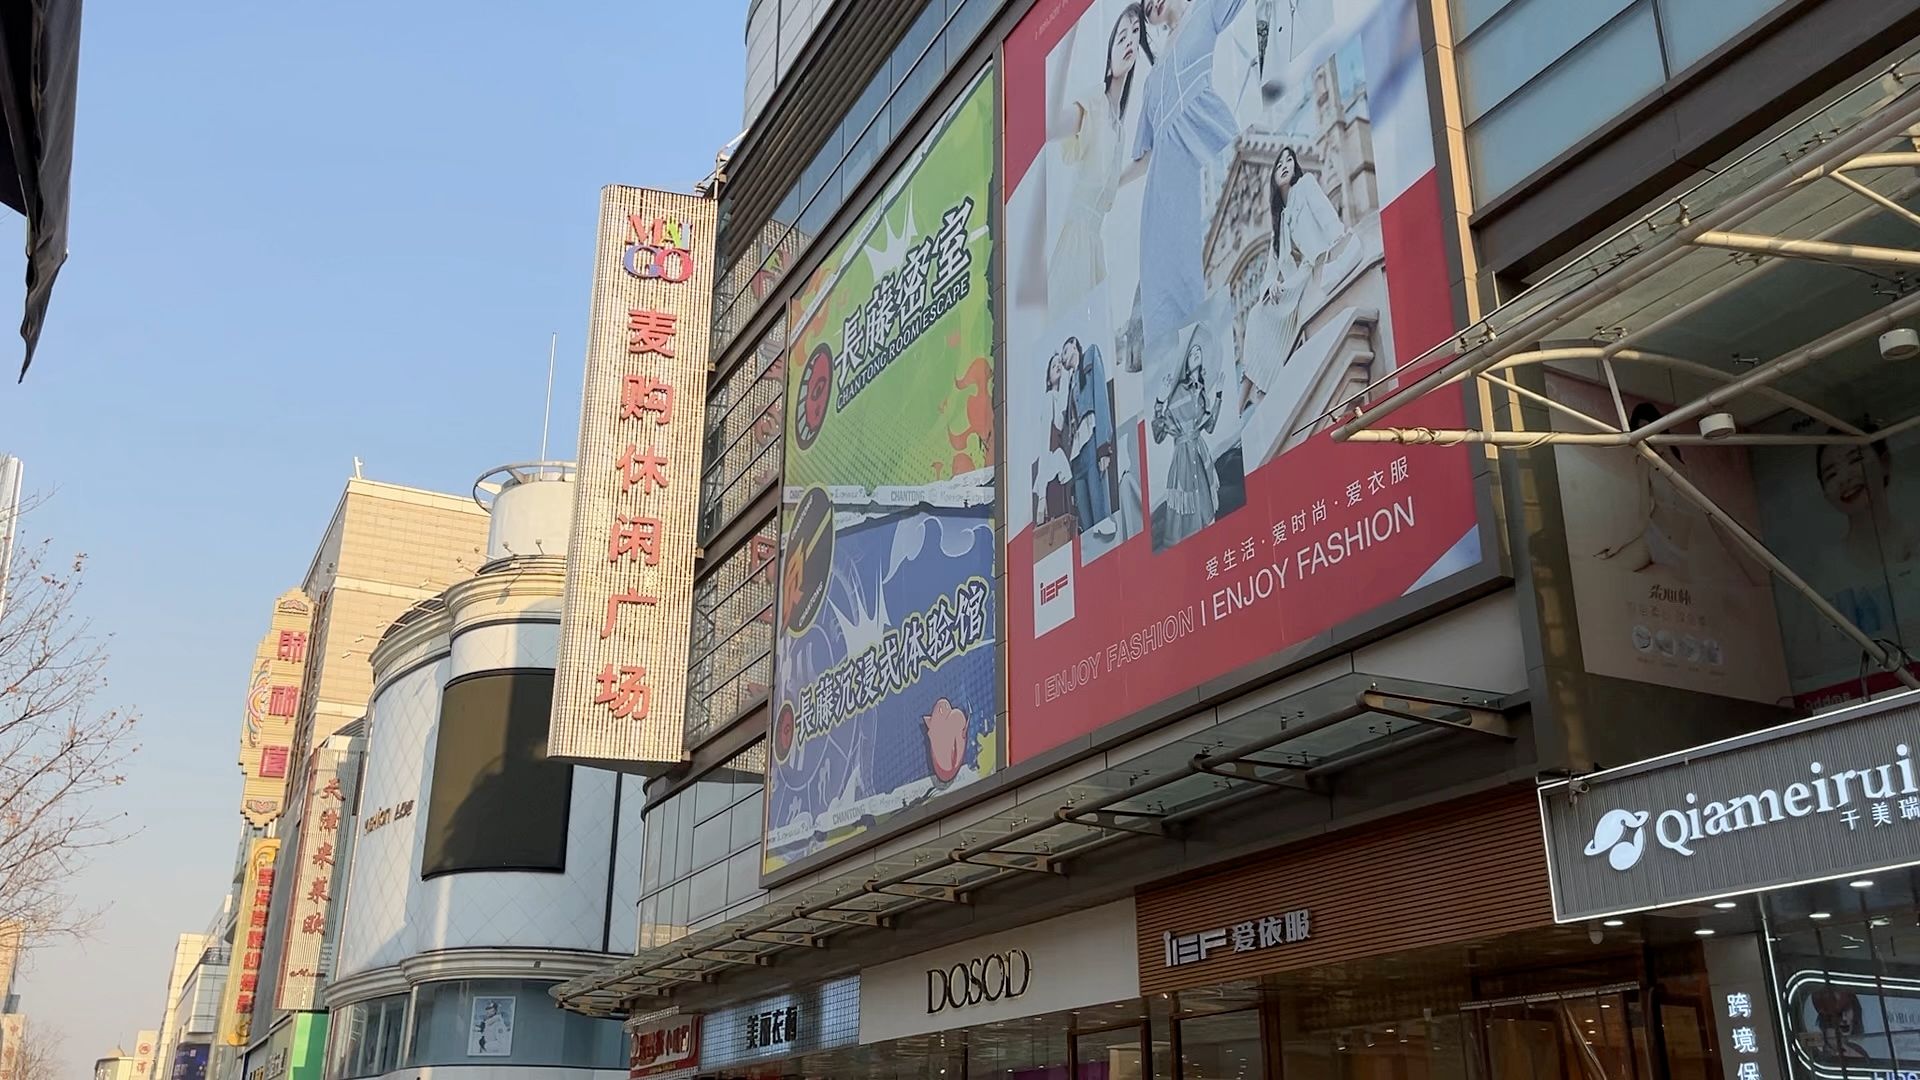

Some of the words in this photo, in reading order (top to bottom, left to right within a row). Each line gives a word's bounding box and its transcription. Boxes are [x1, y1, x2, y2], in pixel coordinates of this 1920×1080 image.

[838, 353, 888, 410] CHANTONG
[889, 322, 920, 358] ROOM
[922, 276, 969, 329] ESCAPE
[594, 309, 677, 720] 麦购休闲广场
[1045, 652, 1102, 703] ENJOY
[1106, 606, 1195, 673] FASHION
[1212, 558, 1289, 621] ENJOY
[1297, 496, 1415, 580] FASHION
[1656, 744, 1919, 856] Qiameirui
[1840, 796, 1920, 831] 千美瑞
[927, 949, 1032, 1014] DOSOD
[1231, 909, 1311, 953] 爱依服
